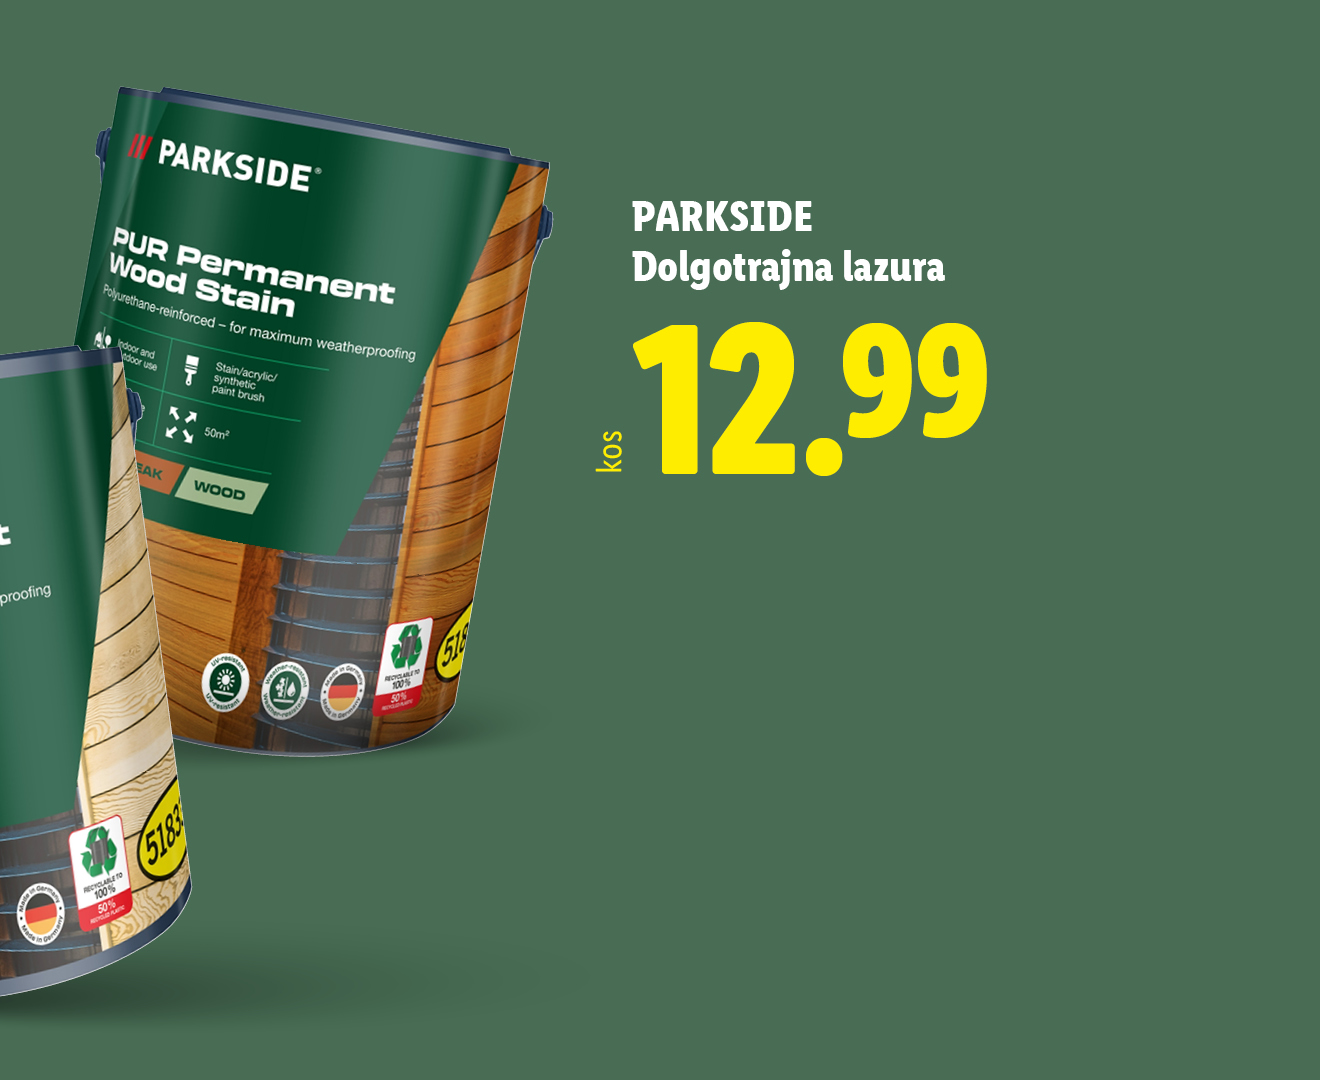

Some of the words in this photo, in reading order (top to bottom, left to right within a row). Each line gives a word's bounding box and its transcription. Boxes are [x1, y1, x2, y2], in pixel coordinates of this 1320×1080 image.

[112, 226, 169, 262] PUR
[176, 244, 396, 305] Permanent
[110, 252, 188, 294] Wood
[195, 277, 296, 318] Stain
[103, 283, 216, 328] Polyurethane-reinforced
[229, 320, 247, 334] for
[250, 326, 313, 347] maximum
[316, 338, 417, 363] weatherproofing
[117, 338, 140, 354] Indoor
[140, 348, 156, 359] and
[122, 352, 143, 366] tdoor
[143, 360, 158, 371] use
[215, 361, 278, 383] Stain/acrylic/
[211, 384, 236, 397] paint
[237, 389, 265, 402] brush
[213, 373, 257, 391] synthetic
[136, 461, 164, 481] EAK
[193, 479, 246, 501] WOOD
[145, 797, 184, 866] 5183
[83, 875, 116, 894] RECYCLABLE
[115, 871, 123, 880] TO
[19, 892, 30, 913] Made
[36, 885, 61, 904] Germany
[21, 924, 36, 942] Made
[43, 914, 64, 943] Germany
